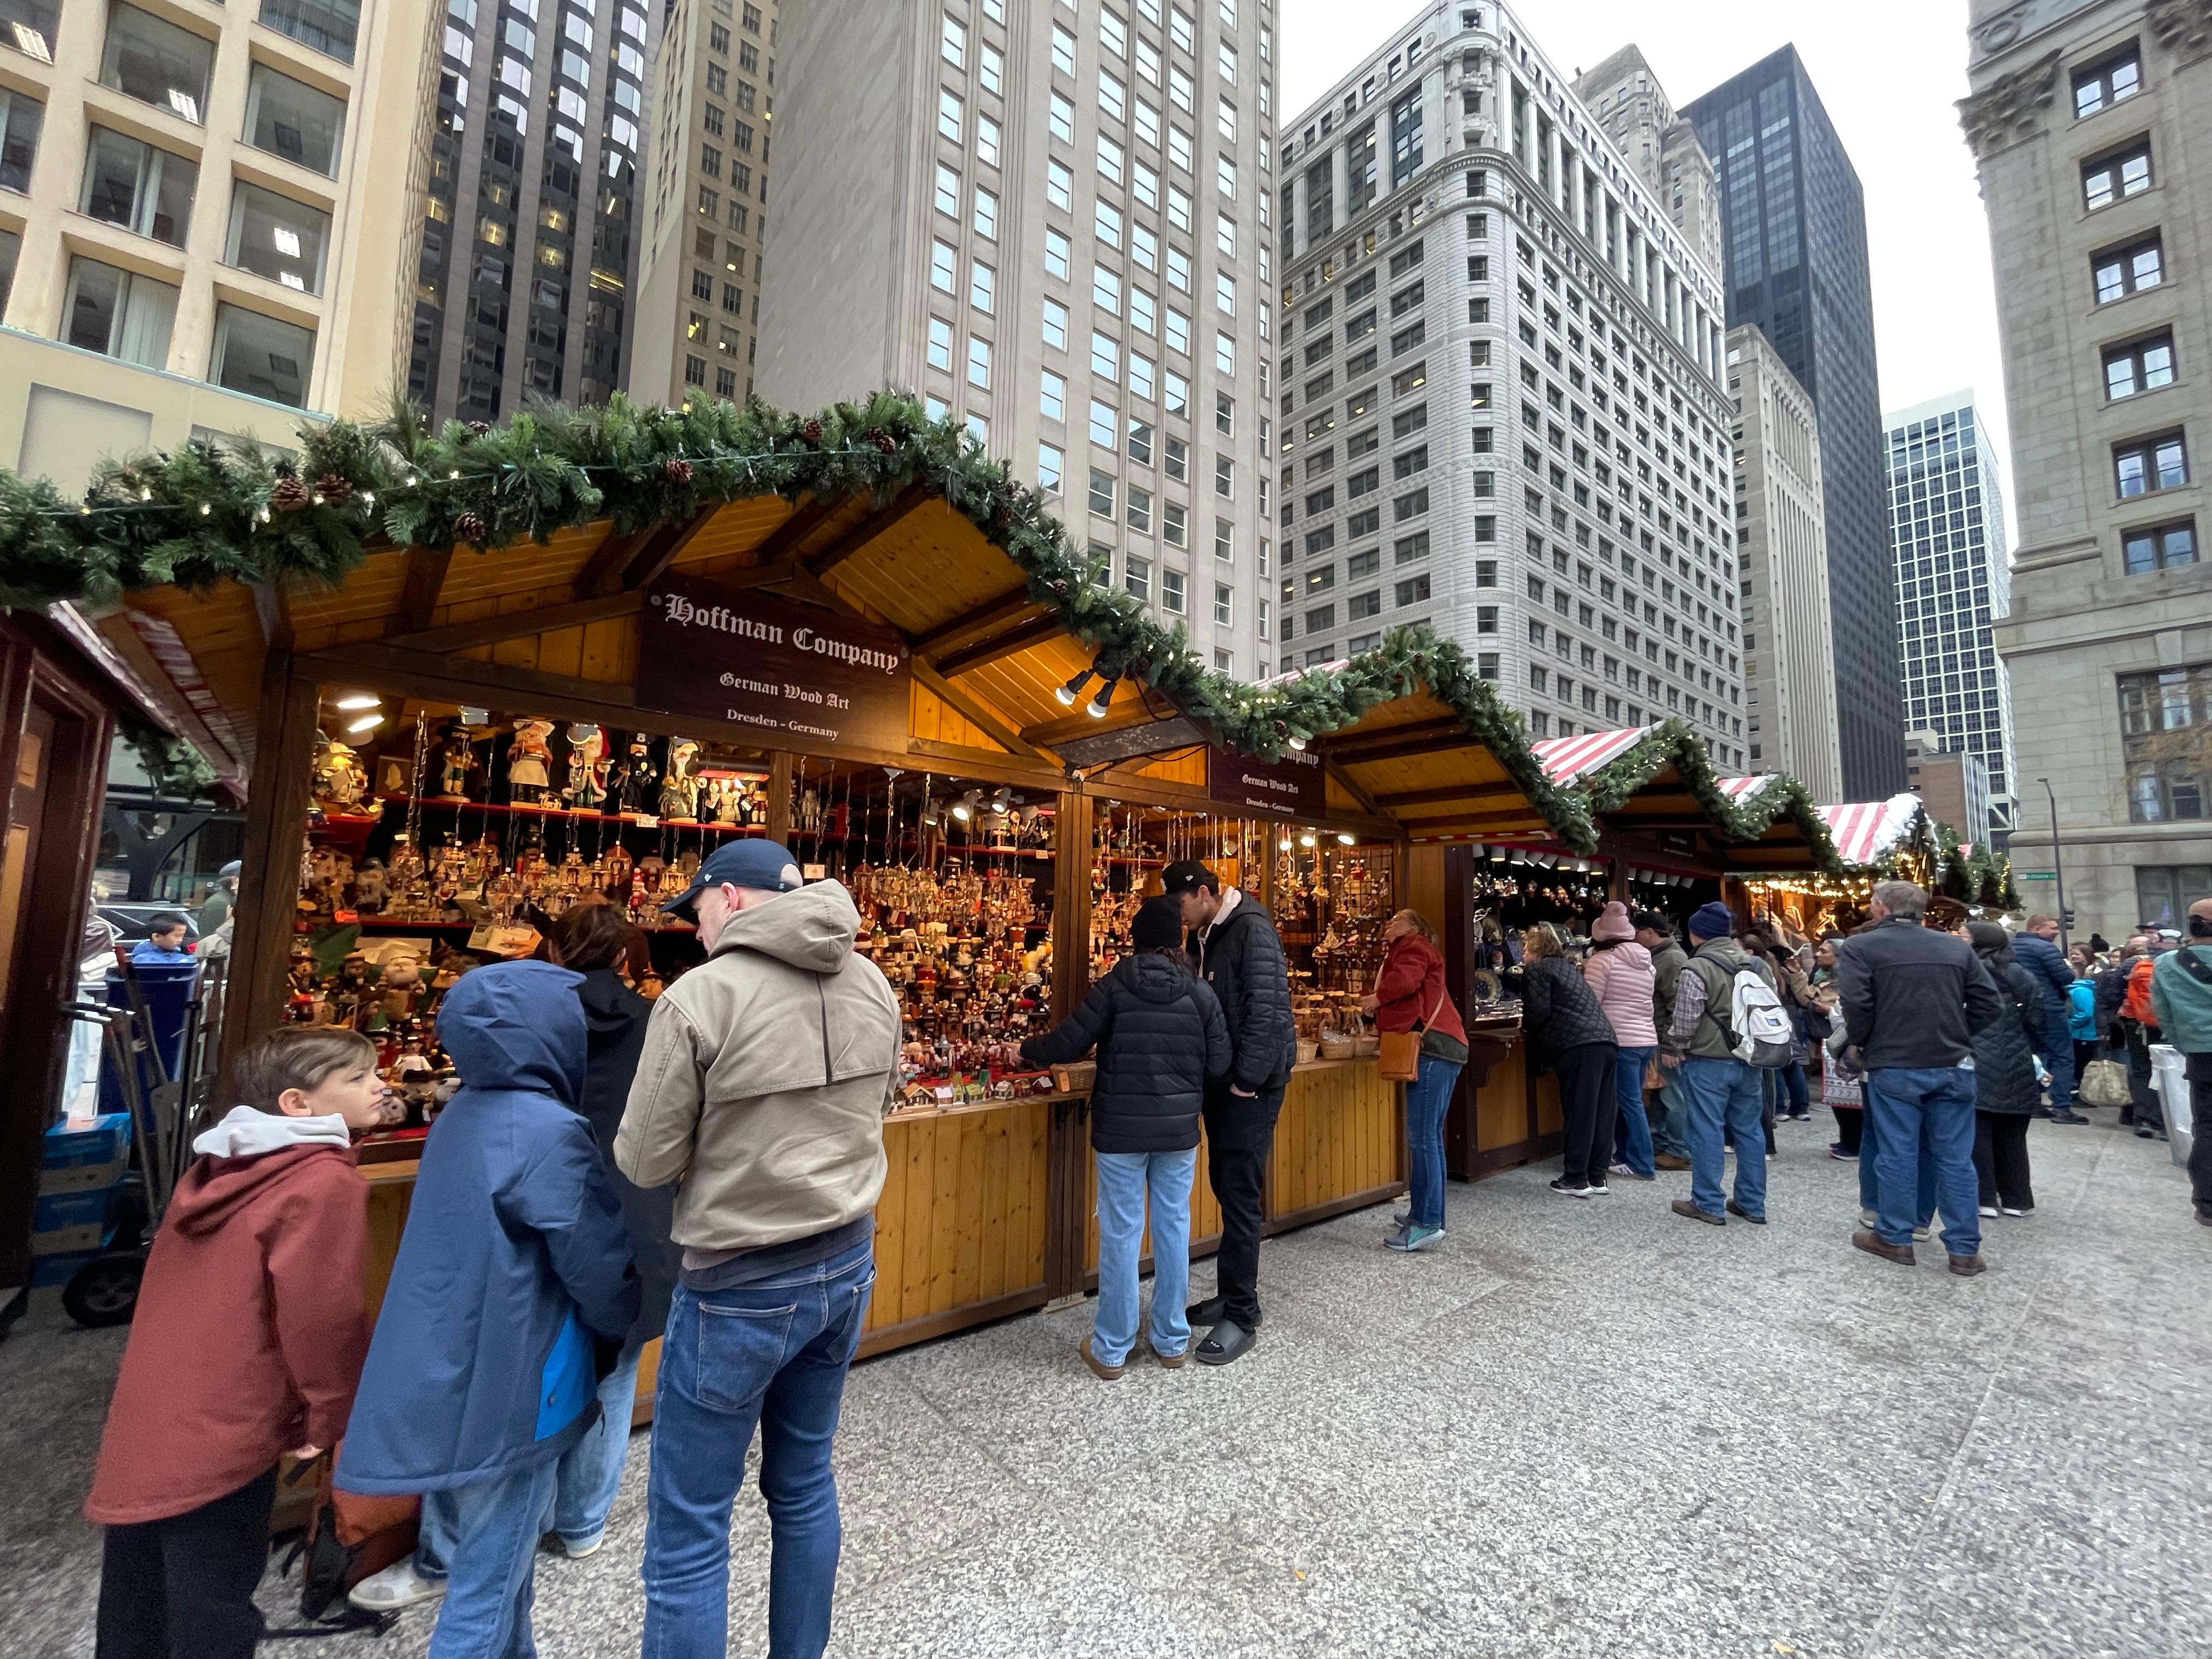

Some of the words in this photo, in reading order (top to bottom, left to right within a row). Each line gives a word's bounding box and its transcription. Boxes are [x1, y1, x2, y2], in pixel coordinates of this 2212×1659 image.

[664, 593, 783, 644] Hoffman
[792, 627, 899, 675] Company
[719, 673, 778, 696] German
[784, 684, 823, 705] Wood
[827, 692, 850, 710] Art
[727, 709, 777, 727] Dresden
[788, 720, 839, 741] Germany
[1242, 774, 1267, 787] German
[1269, 779, 1286, 792] Wood
[1288, 783, 1299, 794] Art
[1246, 797, 1268, 808] Dresden
[1272, 802, 1295, 815] Germany
